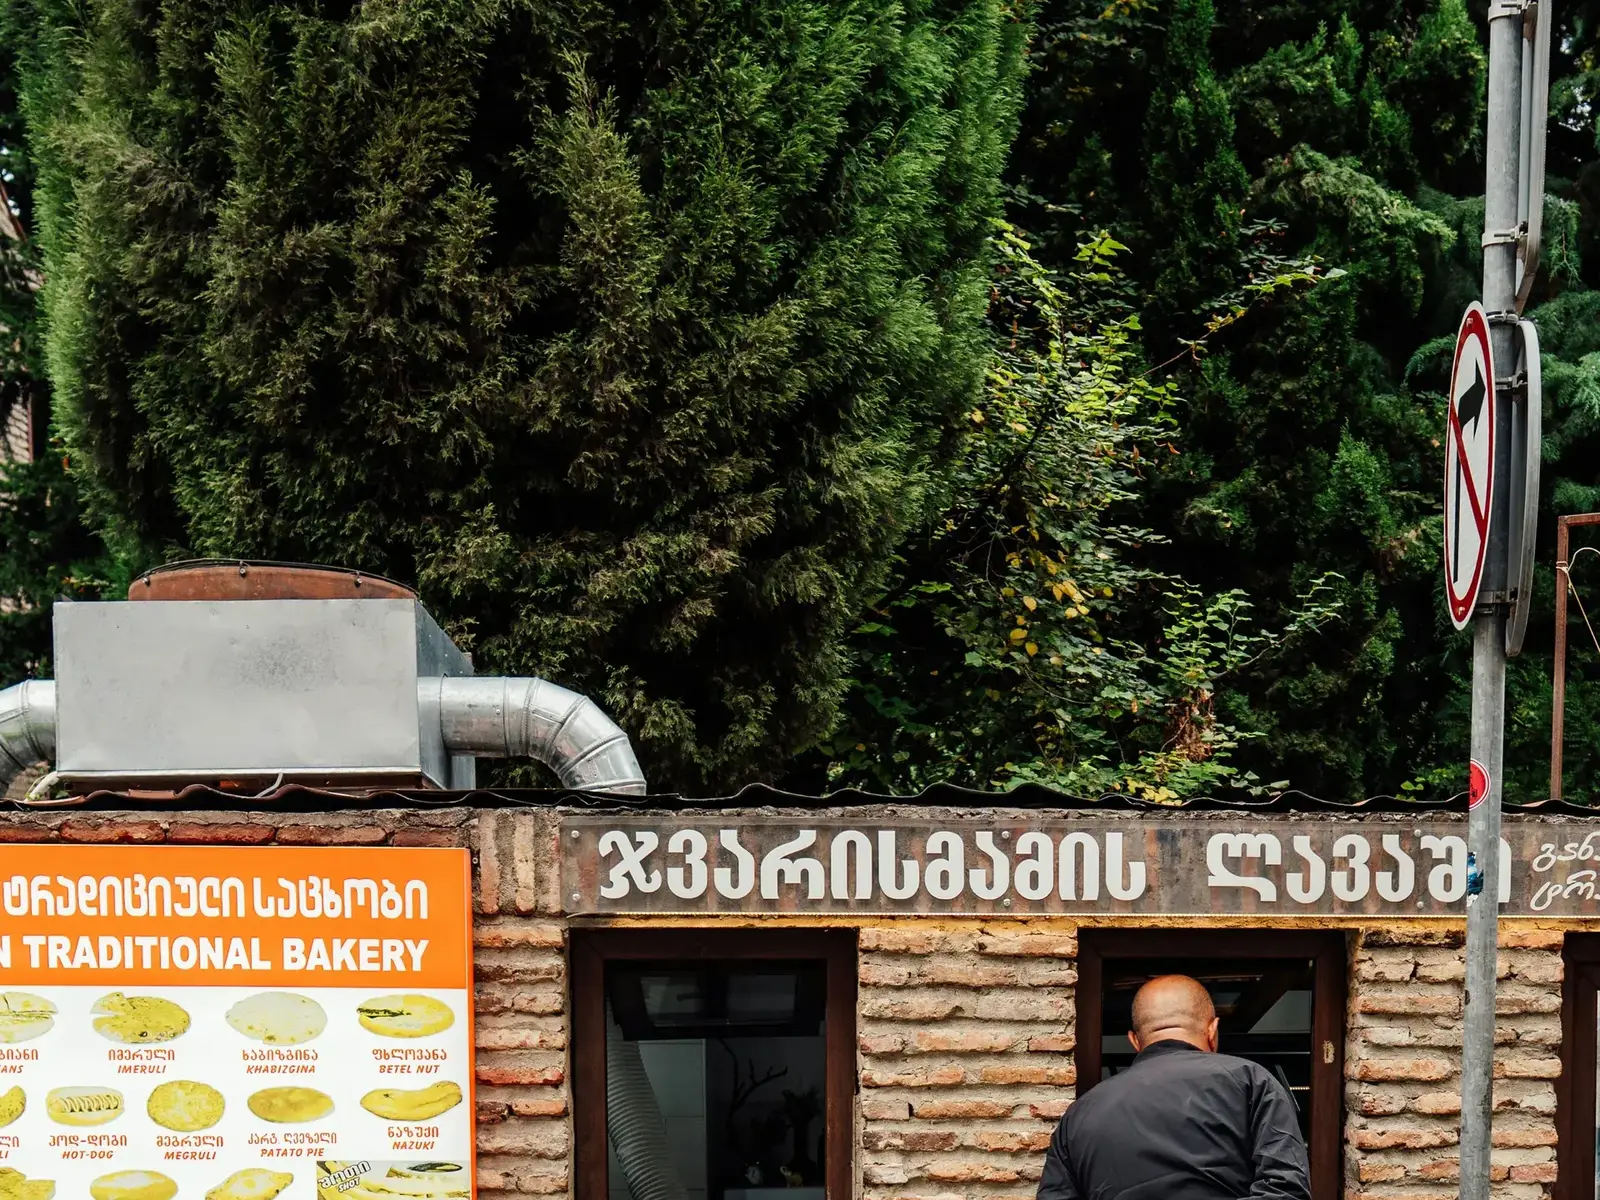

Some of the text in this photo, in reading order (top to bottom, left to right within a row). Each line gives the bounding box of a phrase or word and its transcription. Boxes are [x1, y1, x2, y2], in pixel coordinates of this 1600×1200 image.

[598, 828, 1147, 902] ჯვარისმამის
[2, 874, 428, 920] ტრადიციული საცხობი
[22, 935, 272, 971] TRADITIONAL
[282, 937, 430, 973] BAKERY
[108, 1048, 176, 1061] იმერული
[372, 1048, 448, 1061] ფხლოვანა
[0, 1064, 24, 1074] ANS
[117, 1064, 167, 1074] IMERULI
[246, 1064, 316, 1074] KHABIZGINA
[379, 1064, 441, 1074] BETEL NUT
[387, 1126, 440, 1138] ნაზუქი
[156, 1135, 225, 1148] მეგრული
[283, 1132, 337, 1145] ღვეზელი
[392, 1140, 435, 1151] NAZUKI
[62, 1150, 114, 1160] HOT-DOG
[163, 1151, 217, 1161] MEGRULI
[260, 1147, 325, 1158] PATATO PIE
[338, 1176, 361, 1193] SHOT
